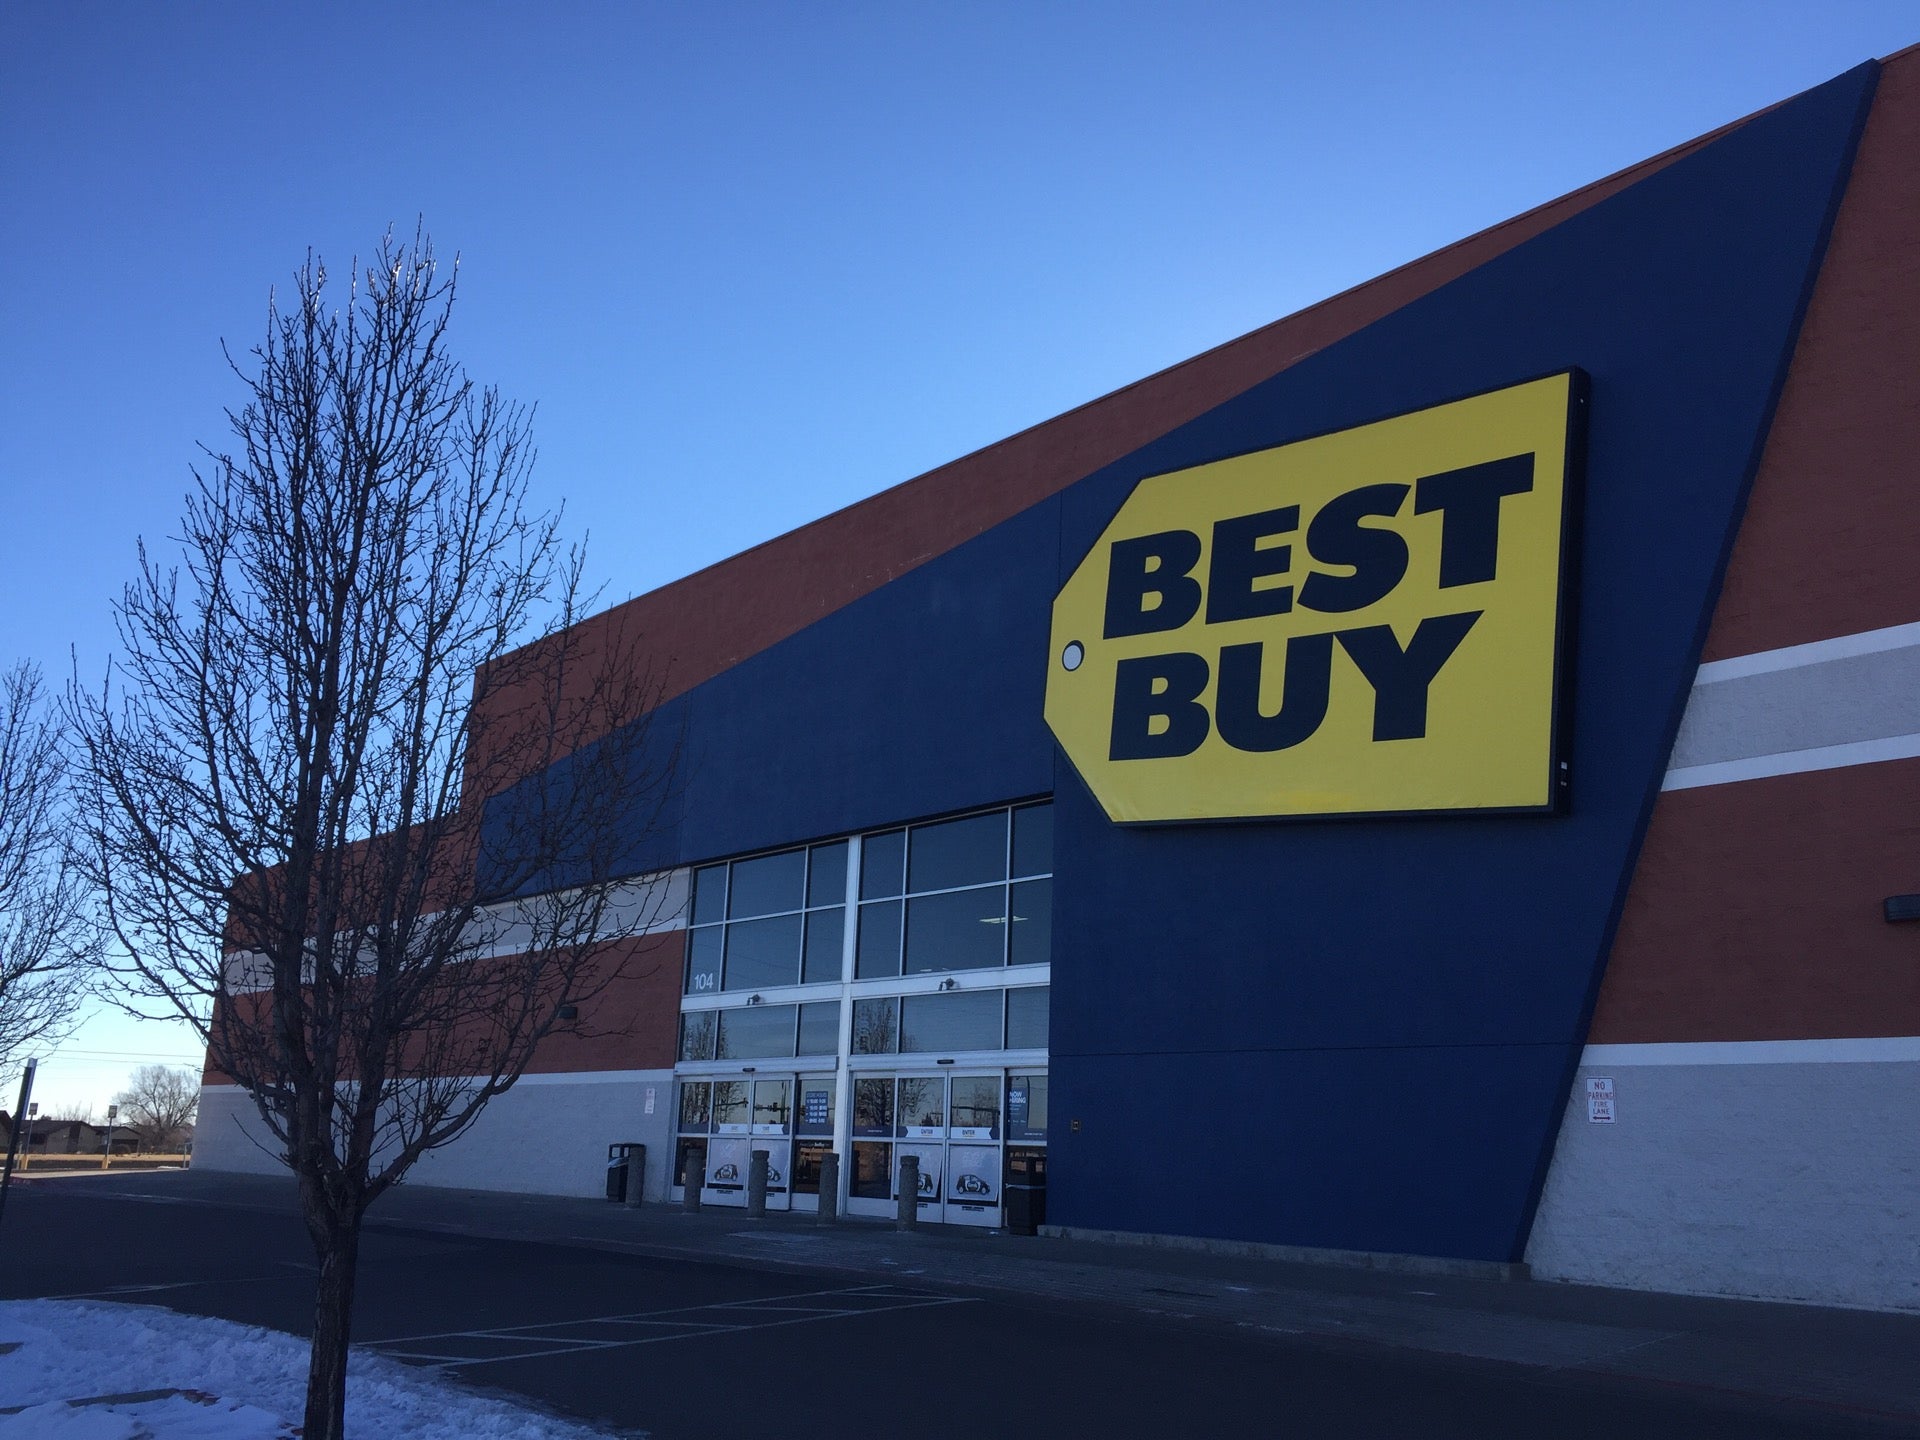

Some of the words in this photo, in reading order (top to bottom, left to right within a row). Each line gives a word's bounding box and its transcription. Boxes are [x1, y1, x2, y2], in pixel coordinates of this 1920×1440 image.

[1103, 451, 1536, 640] BEST
[1109, 610, 1485, 761] BUY
[694, 973, 714, 990] 104
[1594, 1082, 1605, 1090] NO
[1588, 1092, 1613, 1100] PARKING
